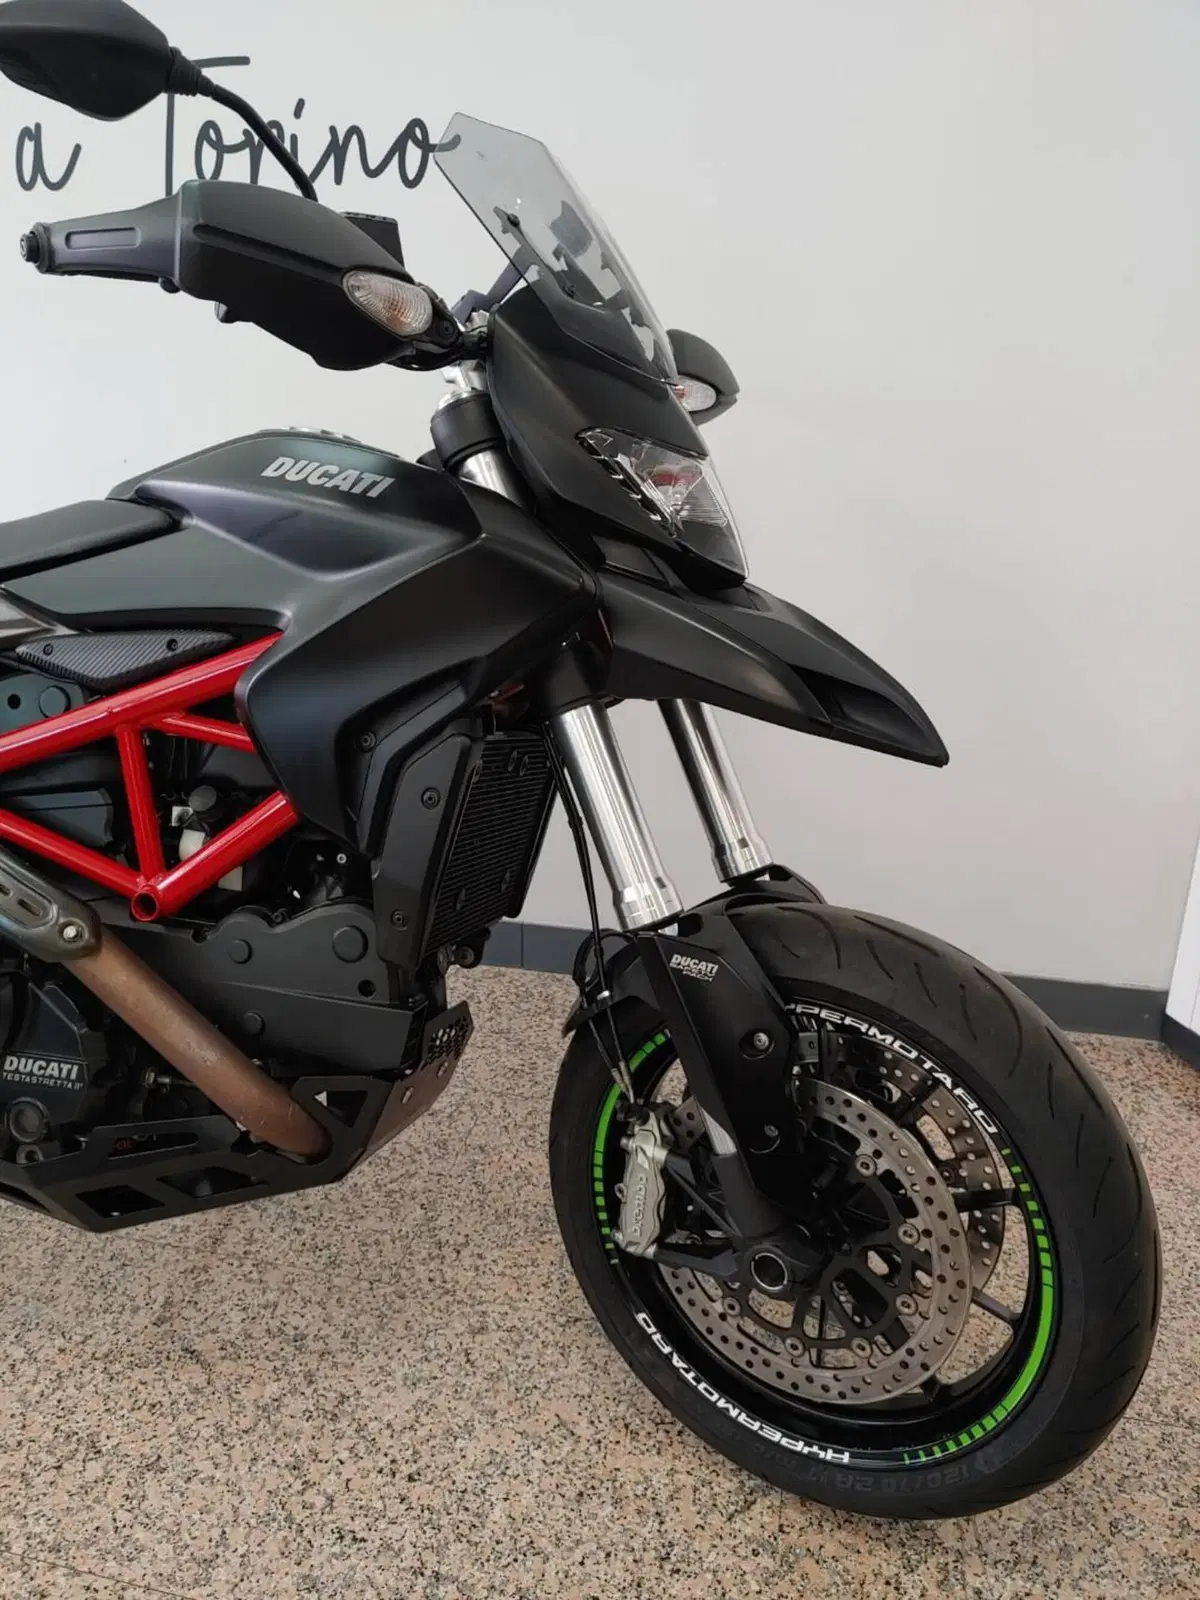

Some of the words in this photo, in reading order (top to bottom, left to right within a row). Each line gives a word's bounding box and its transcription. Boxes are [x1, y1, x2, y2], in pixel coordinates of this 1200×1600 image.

[16, 122, 82, 191] a
[165, 56, 461, 198] Torino
[260, 456, 396, 498] DUCATI
[670, 953, 719, 974] DUCATI
[2, 1072, 73, 1090] TESTASTRETTA
[3, 1055, 79, 1080] DUCATI
[784, 1003, 999, 1134] PERMOTARD
[635, 1312, 850, 1464] HYPERMOTARD
